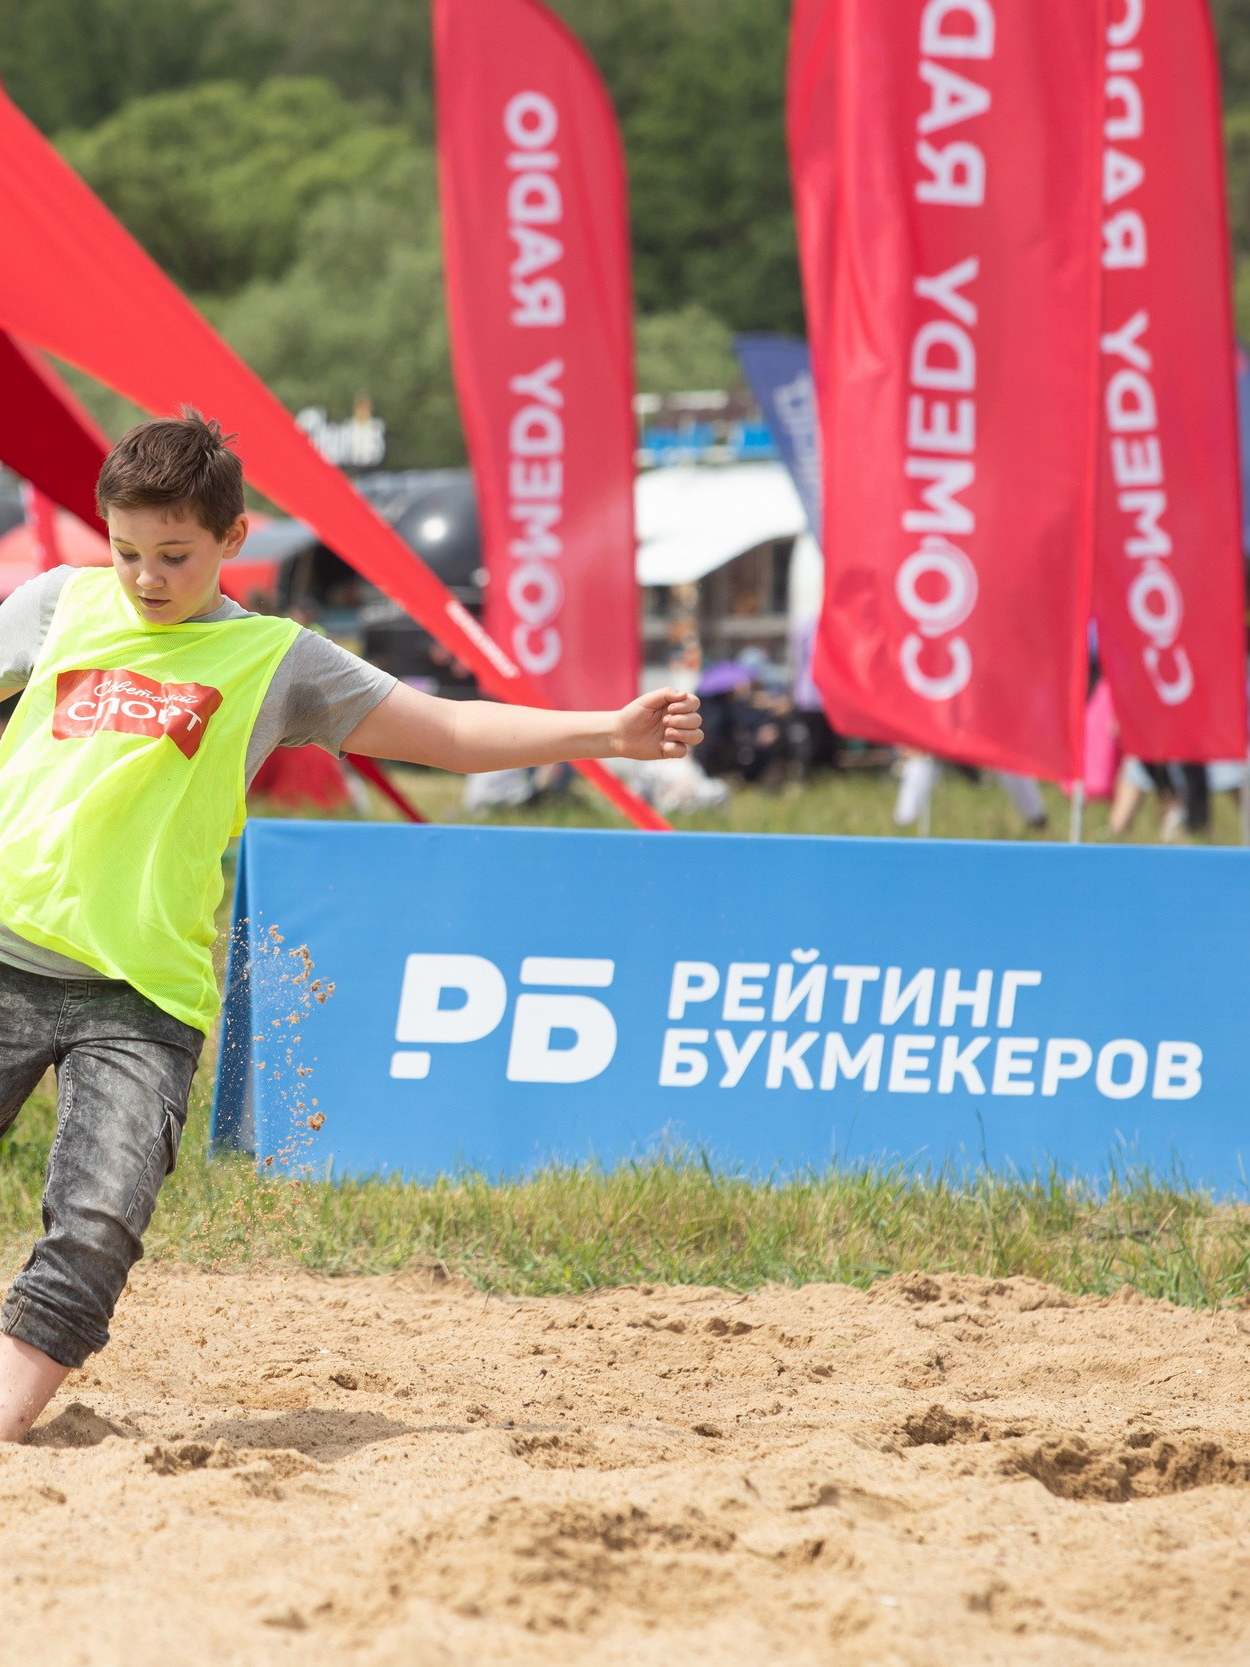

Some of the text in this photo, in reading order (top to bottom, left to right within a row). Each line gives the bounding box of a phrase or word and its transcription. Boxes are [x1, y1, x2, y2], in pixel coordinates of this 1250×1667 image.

[66, 696, 203, 732] СПОРТ
[389, 952, 618, 1084] РБ
[667, 947, 1043, 1029] РЕЙТИНГ
[658, 1027, 1204, 1101] БУКМЕКЕРОВ
